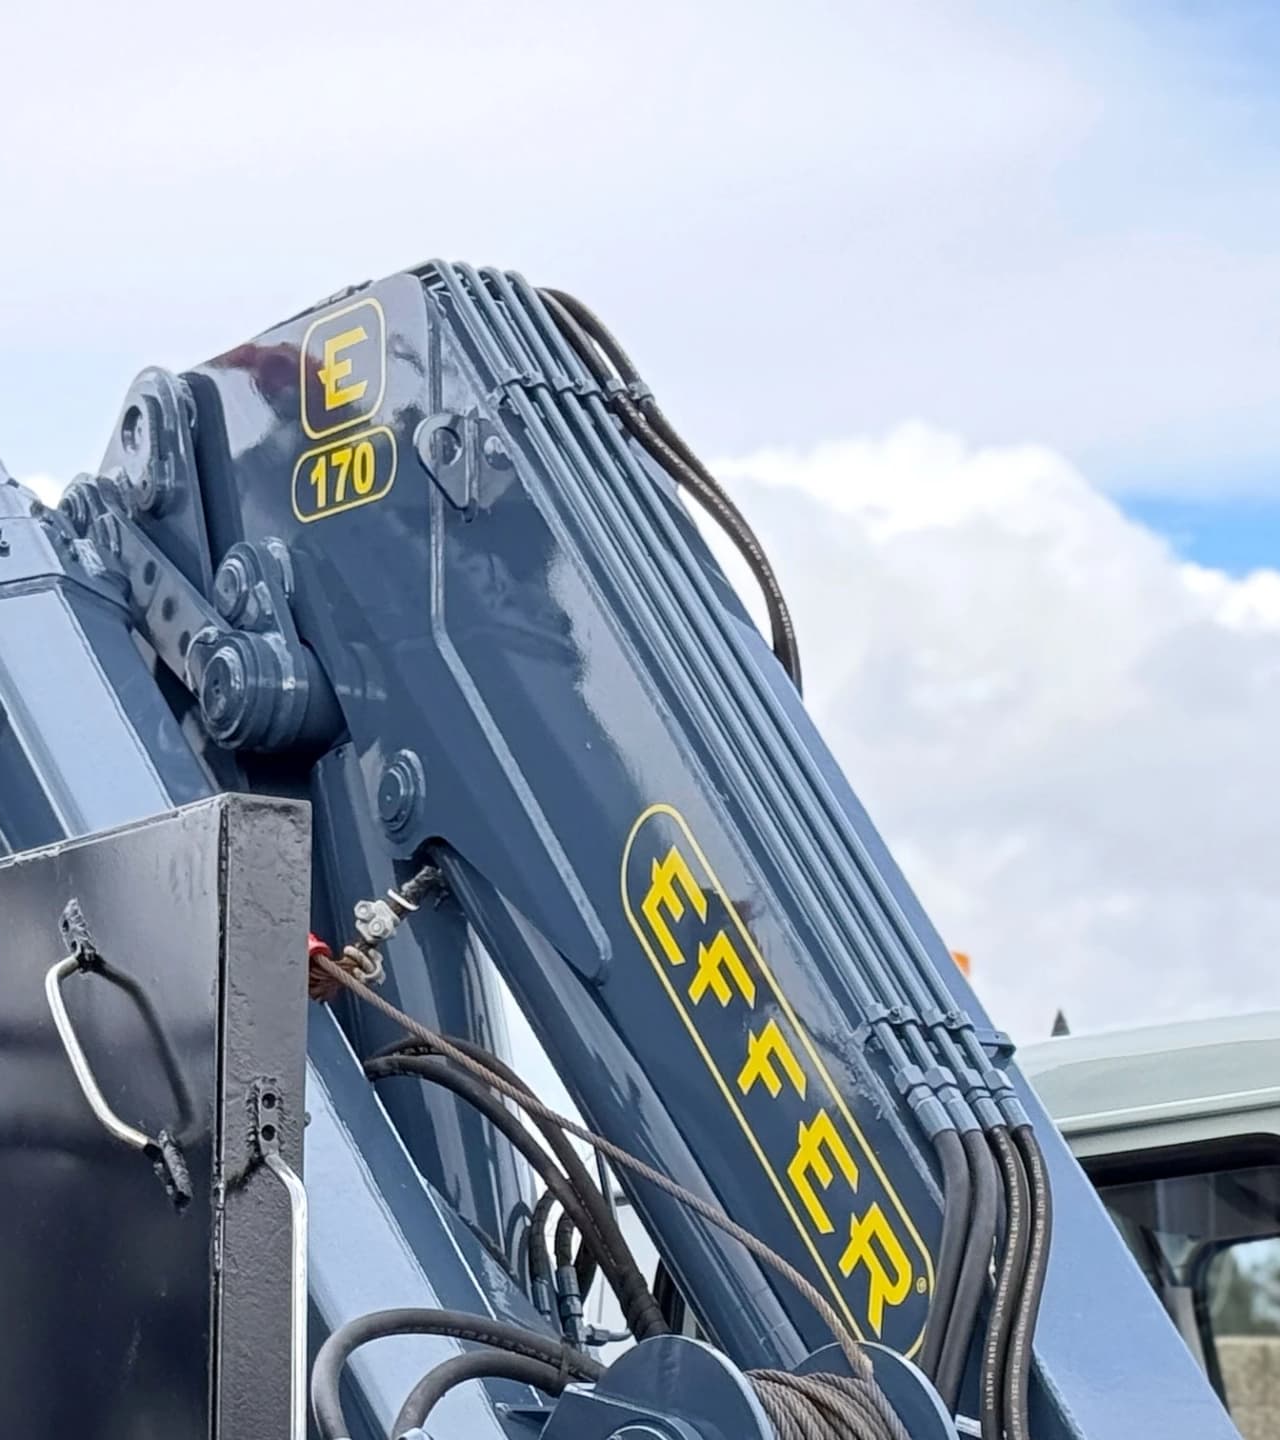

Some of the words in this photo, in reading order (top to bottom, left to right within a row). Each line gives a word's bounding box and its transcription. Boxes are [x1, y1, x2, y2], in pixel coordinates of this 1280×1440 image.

[317, 325, 369, 412] E
[309, 441, 376, 509] 170
[640, 845, 914, 1340] EFFER
